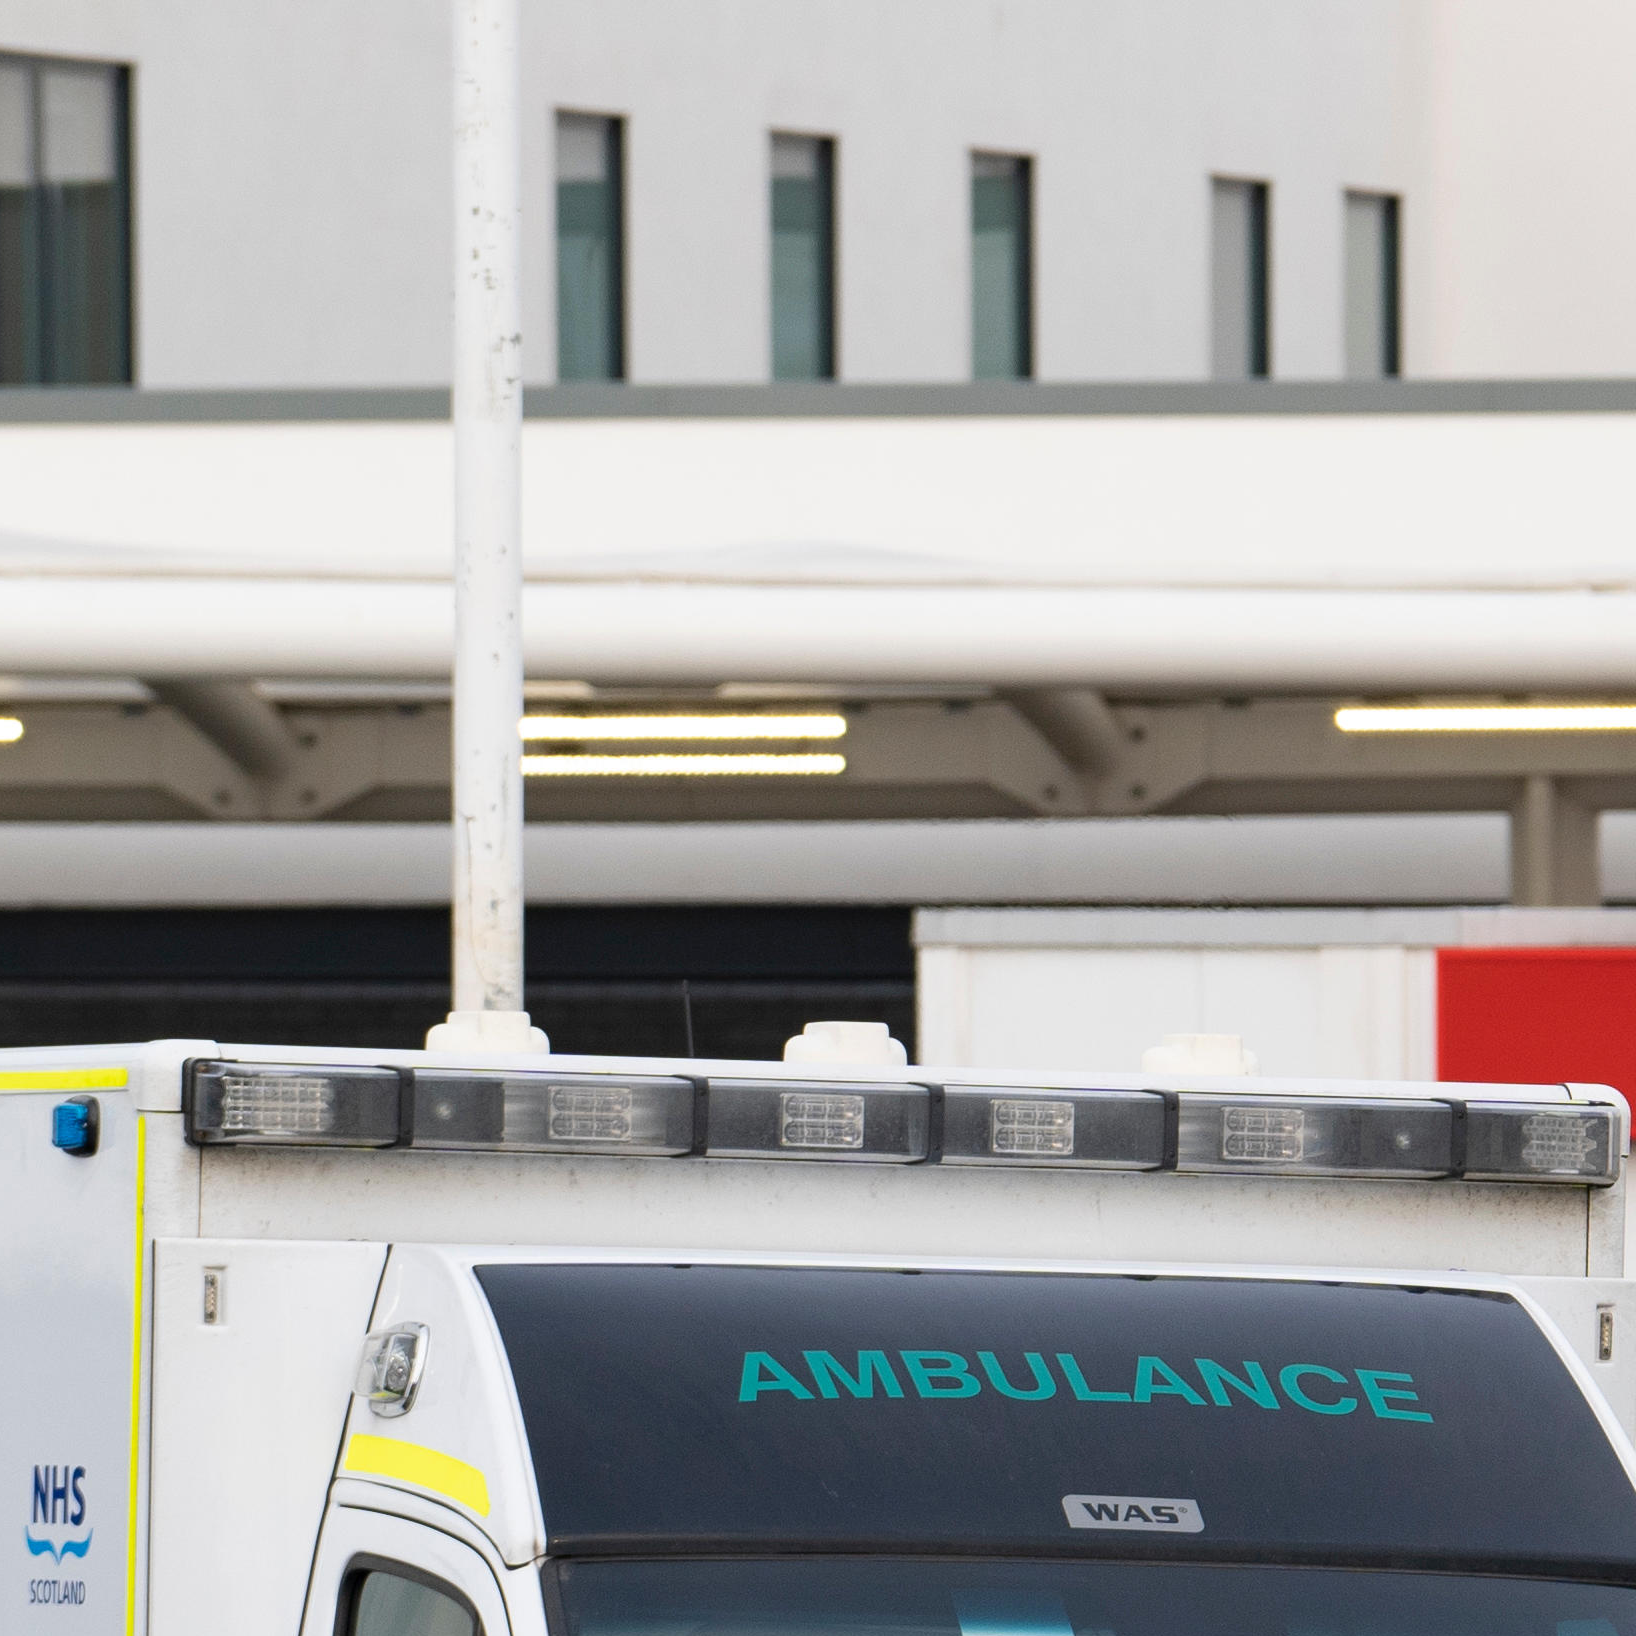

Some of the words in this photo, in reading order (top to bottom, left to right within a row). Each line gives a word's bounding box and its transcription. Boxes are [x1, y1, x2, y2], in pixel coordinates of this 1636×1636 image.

[738, 1350, 1434, 1423] AMBULANCE
[32, 1464, 86, 1526] NHS
[30, 1579, 86, 1605] SCOTLAND
